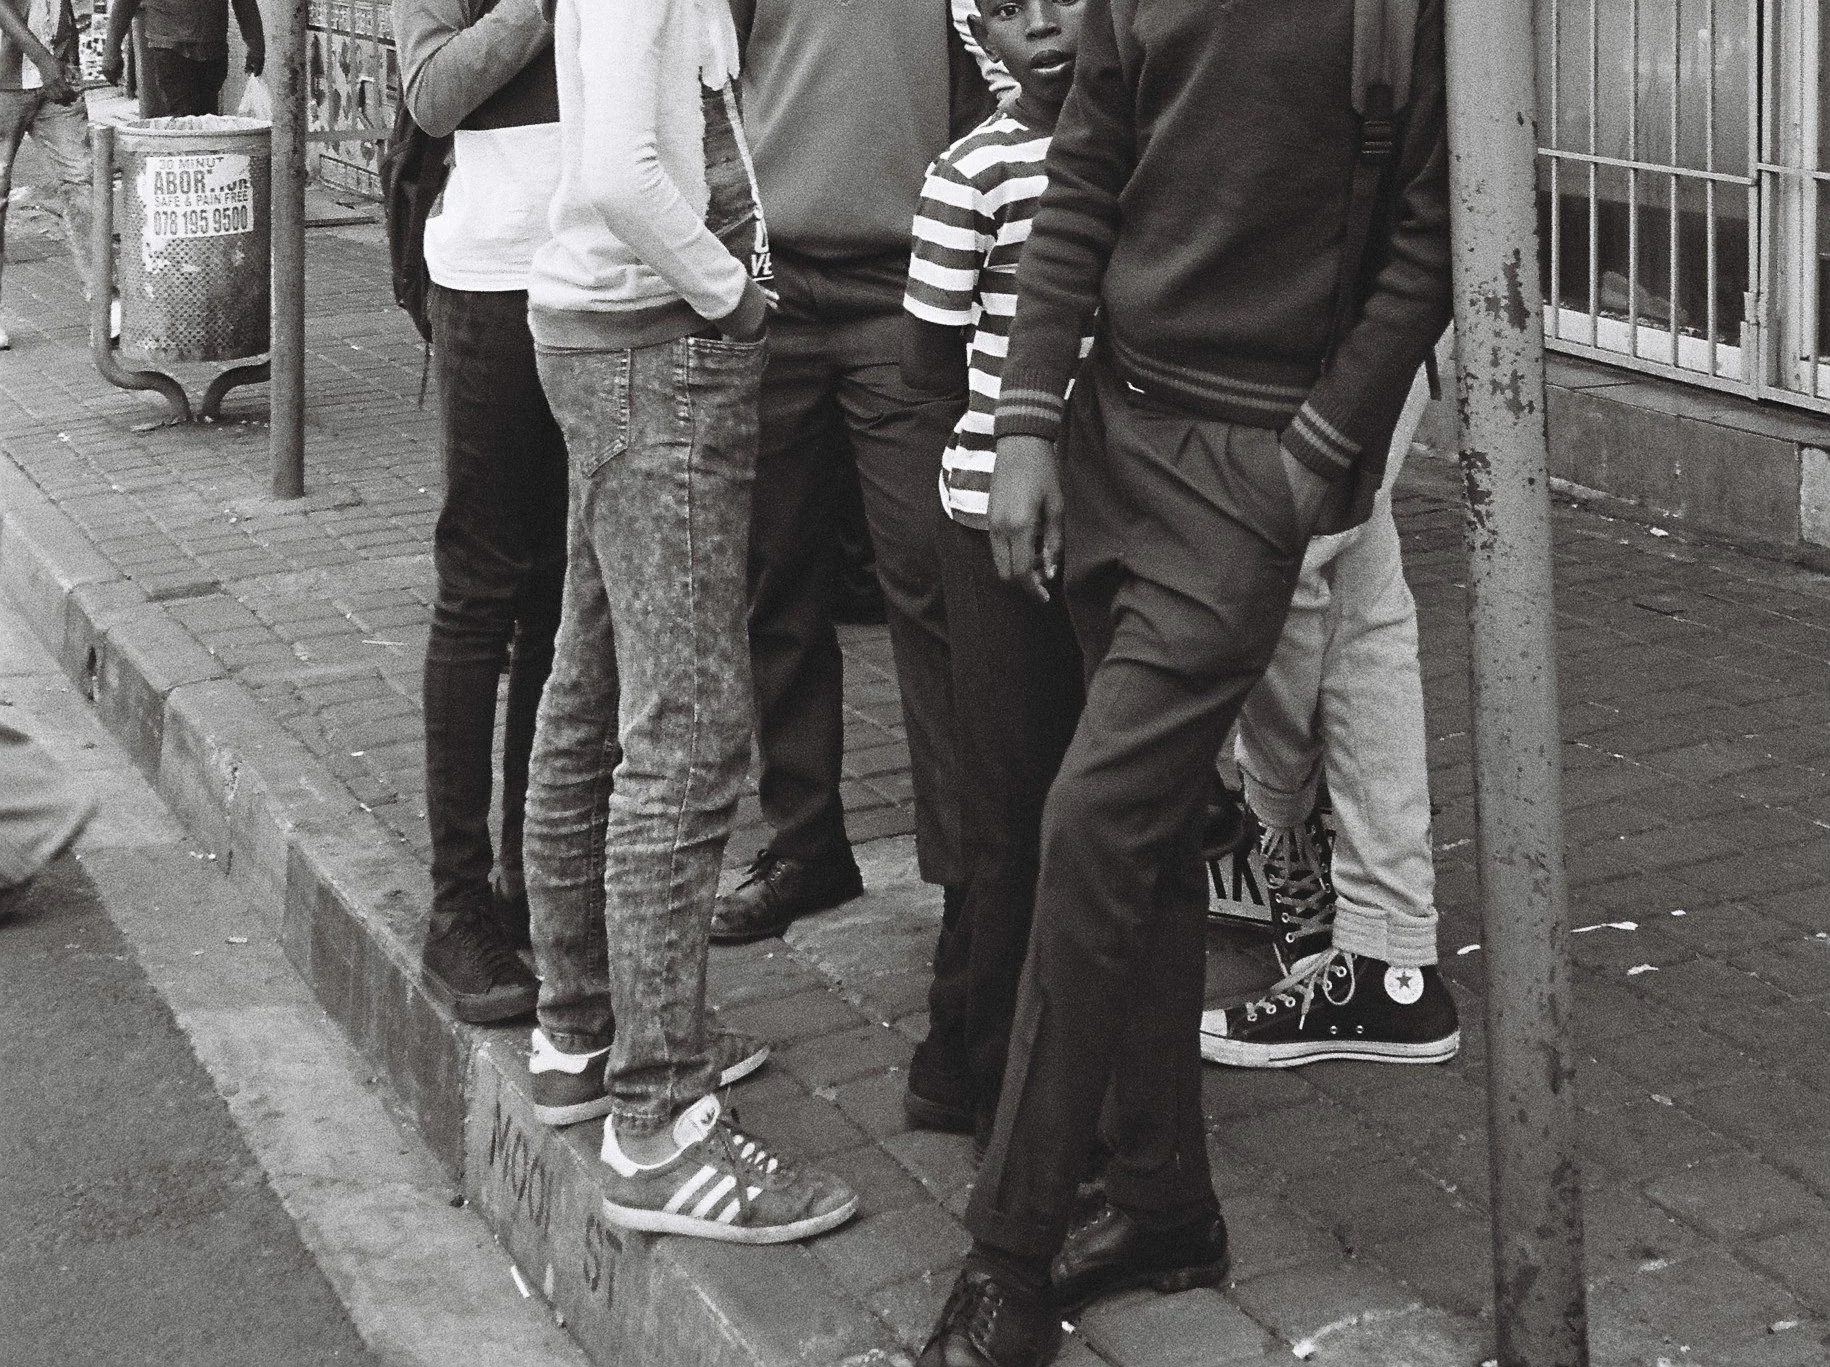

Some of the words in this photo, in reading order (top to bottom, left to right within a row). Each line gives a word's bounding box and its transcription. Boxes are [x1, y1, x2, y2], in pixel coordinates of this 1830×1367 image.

[154, 196, 180, 208] SAFE
[196, 193, 222, 206] PAIN
[224, 190, 249, 204] FREE
[153, 210, 178, 236] 078
[182, 209, 208, 235] 195
[213, 204, 248, 233] 9500
